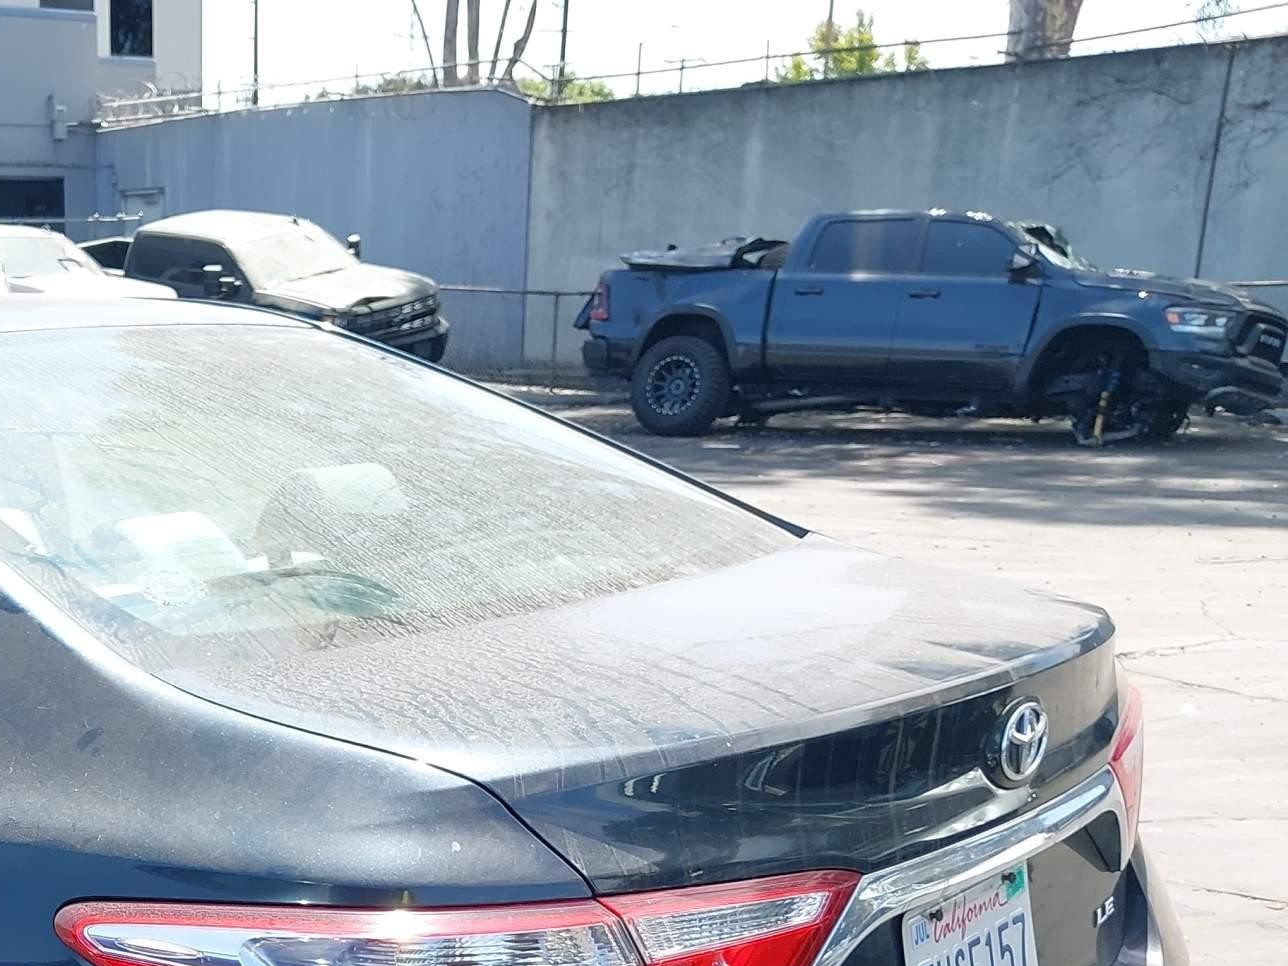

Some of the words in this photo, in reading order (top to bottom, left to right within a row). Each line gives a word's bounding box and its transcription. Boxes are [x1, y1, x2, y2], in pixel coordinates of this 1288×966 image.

[933, 890, 1009, 944] California
[1096, 895, 1115, 925] LE
[914, 920, 931, 947] JUL
